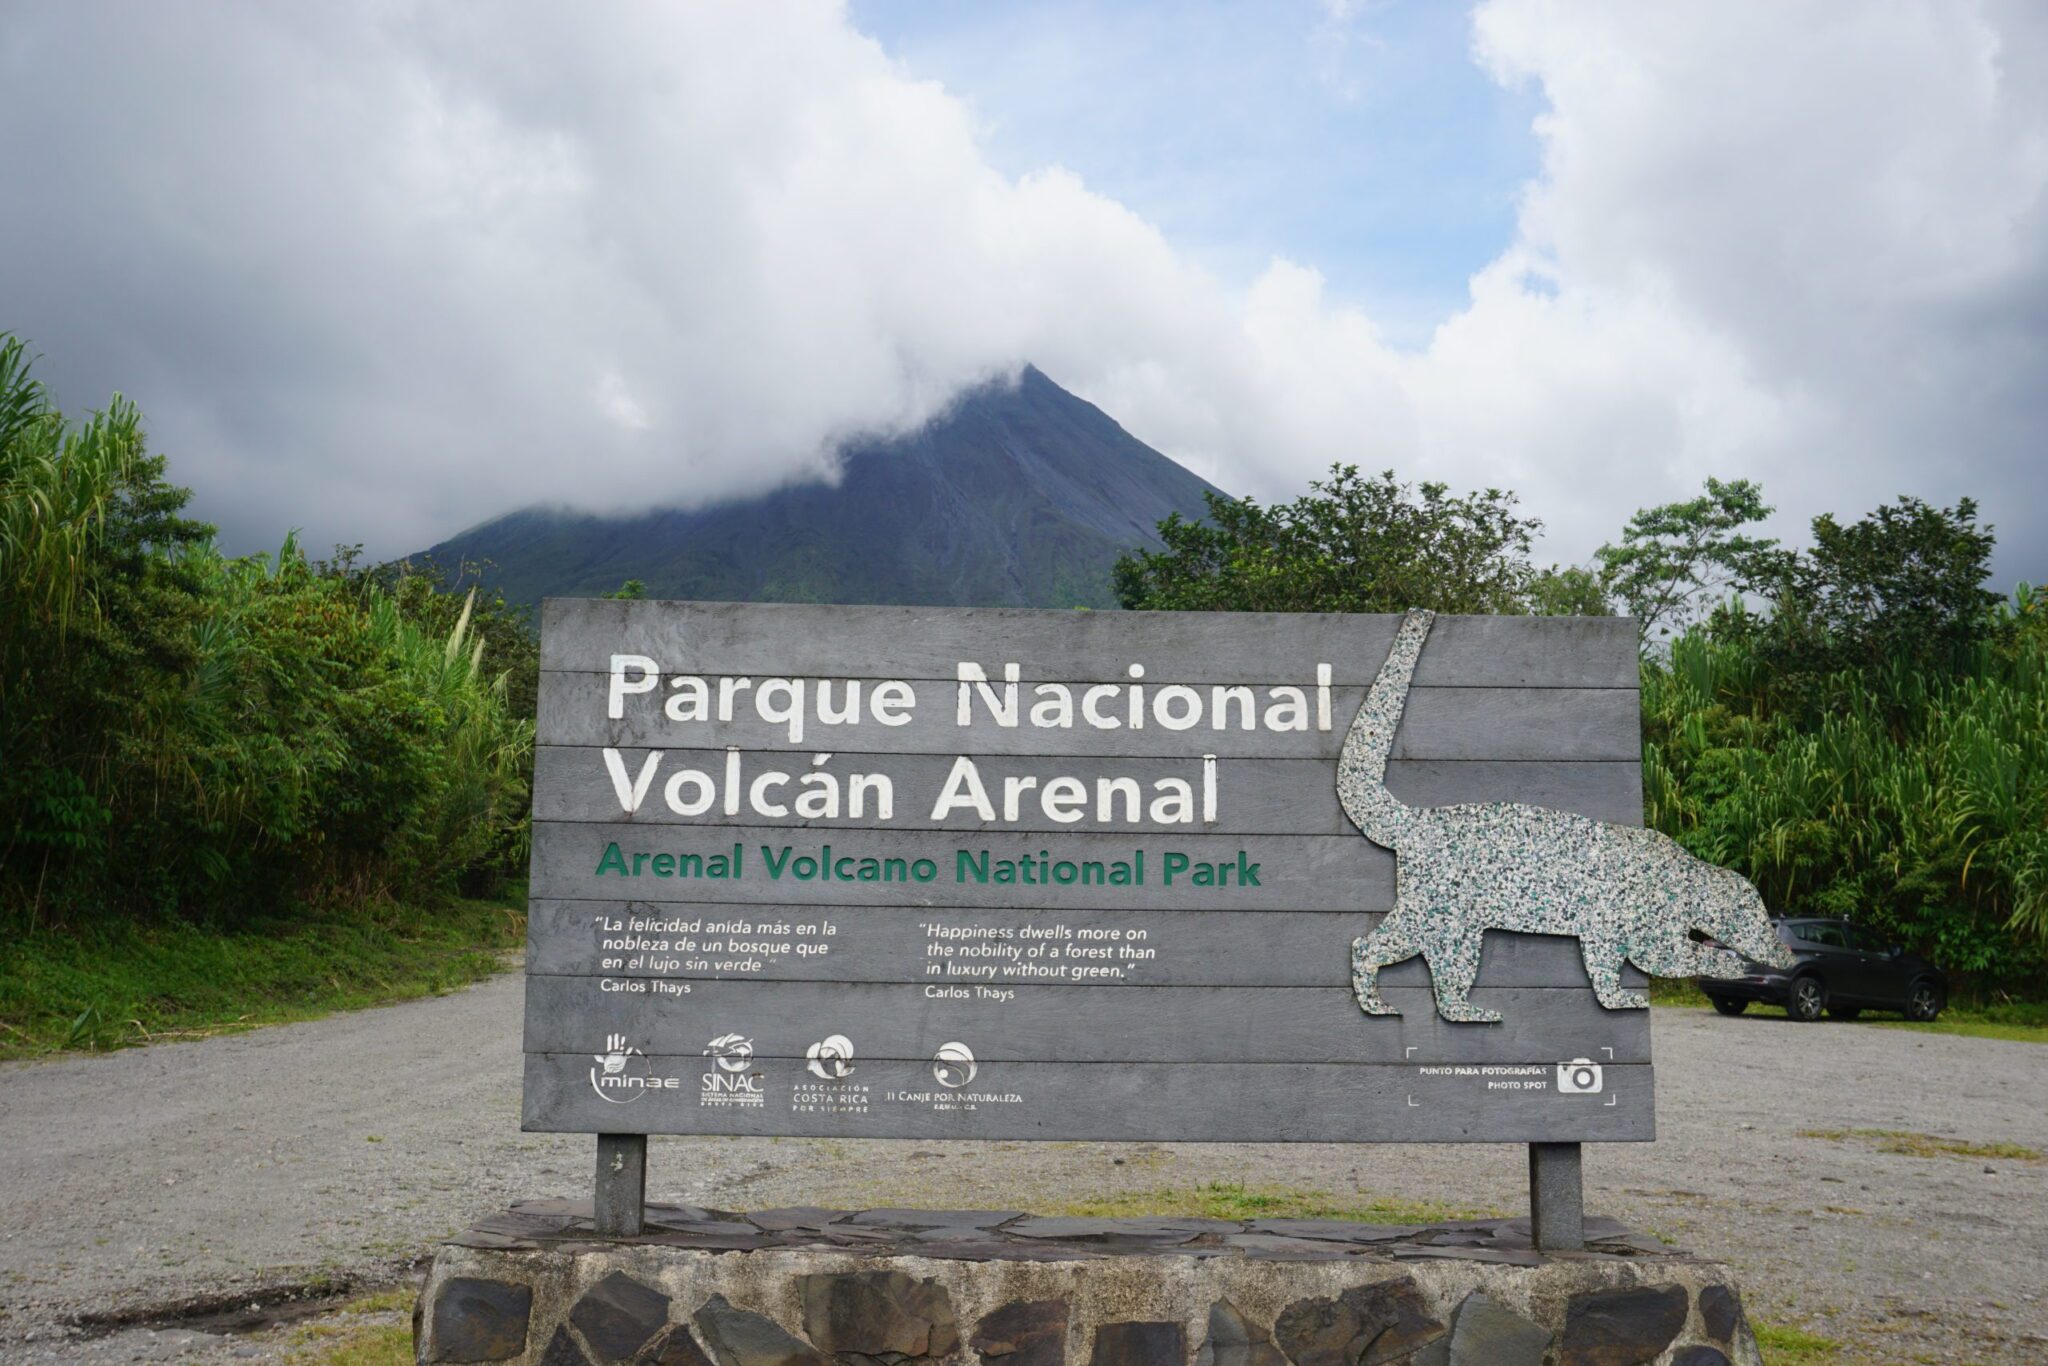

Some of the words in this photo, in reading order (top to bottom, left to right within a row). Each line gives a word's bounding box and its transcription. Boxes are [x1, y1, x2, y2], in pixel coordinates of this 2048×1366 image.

[608, 654, 916, 743] Parque
[957, 661, 1332, 731] Nacional
[603, 745, 893, 820] Volcán
[931, 753, 1217, 825] Arenal
[595, 842, 743, 880] Arenal
[761, 845, 937, 883] Volcano
[956, 850, 1144, 886] National
[1163, 851, 1261, 887] Park
[629, 918, 701, 933] felicidad
[706, 920, 751, 934] anida
[757, 920, 790, 934] más
[796, 924, 816, 935] en
[823, 921, 836, 935] la
[1020, 925, 1071, 939] dwells
[1077, 928, 1120, 940] more
[1126, 930, 1147, 940] on
[603, 935, 668, 950] nobleza
[675, 937, 696, 951] de
[702, 941, 722, 952] un
[728, 938, 790, 956] bosque
[796, 942, 828, 957] que
[927, 943, 953, 956] the
[960, 943, 1023, 961] nobility
[1028, 943, 1046, 957] of
[1050, 948, 1059, 957] a
[1066, 943, 1113, 959] forest
[1119, 945, 1155, 959] than
[602, 958, 622, 969] en
[629, 956, 643, 968] el
[649, 956, 680, 973] lujo
[685, 957, 708, 970] sin
[926, 962, 941, 975] in
[947, 962, 997, 978] luxury
[1002, 962, 1068, 977] without
[600, 979, 646, 993] Carlos
[651, 981, 691, 996] Thays
[925, 986, 970, 999] Carlos
[975, 987, 1014, 1002] Thays
[1420, 1067, 1452, 1075] PUNTO
[702, 1073, 764, 1092] SINAC
[793, 1093, 833, 1103] COSTA
[840, 1095, 868, 1103] RICA
